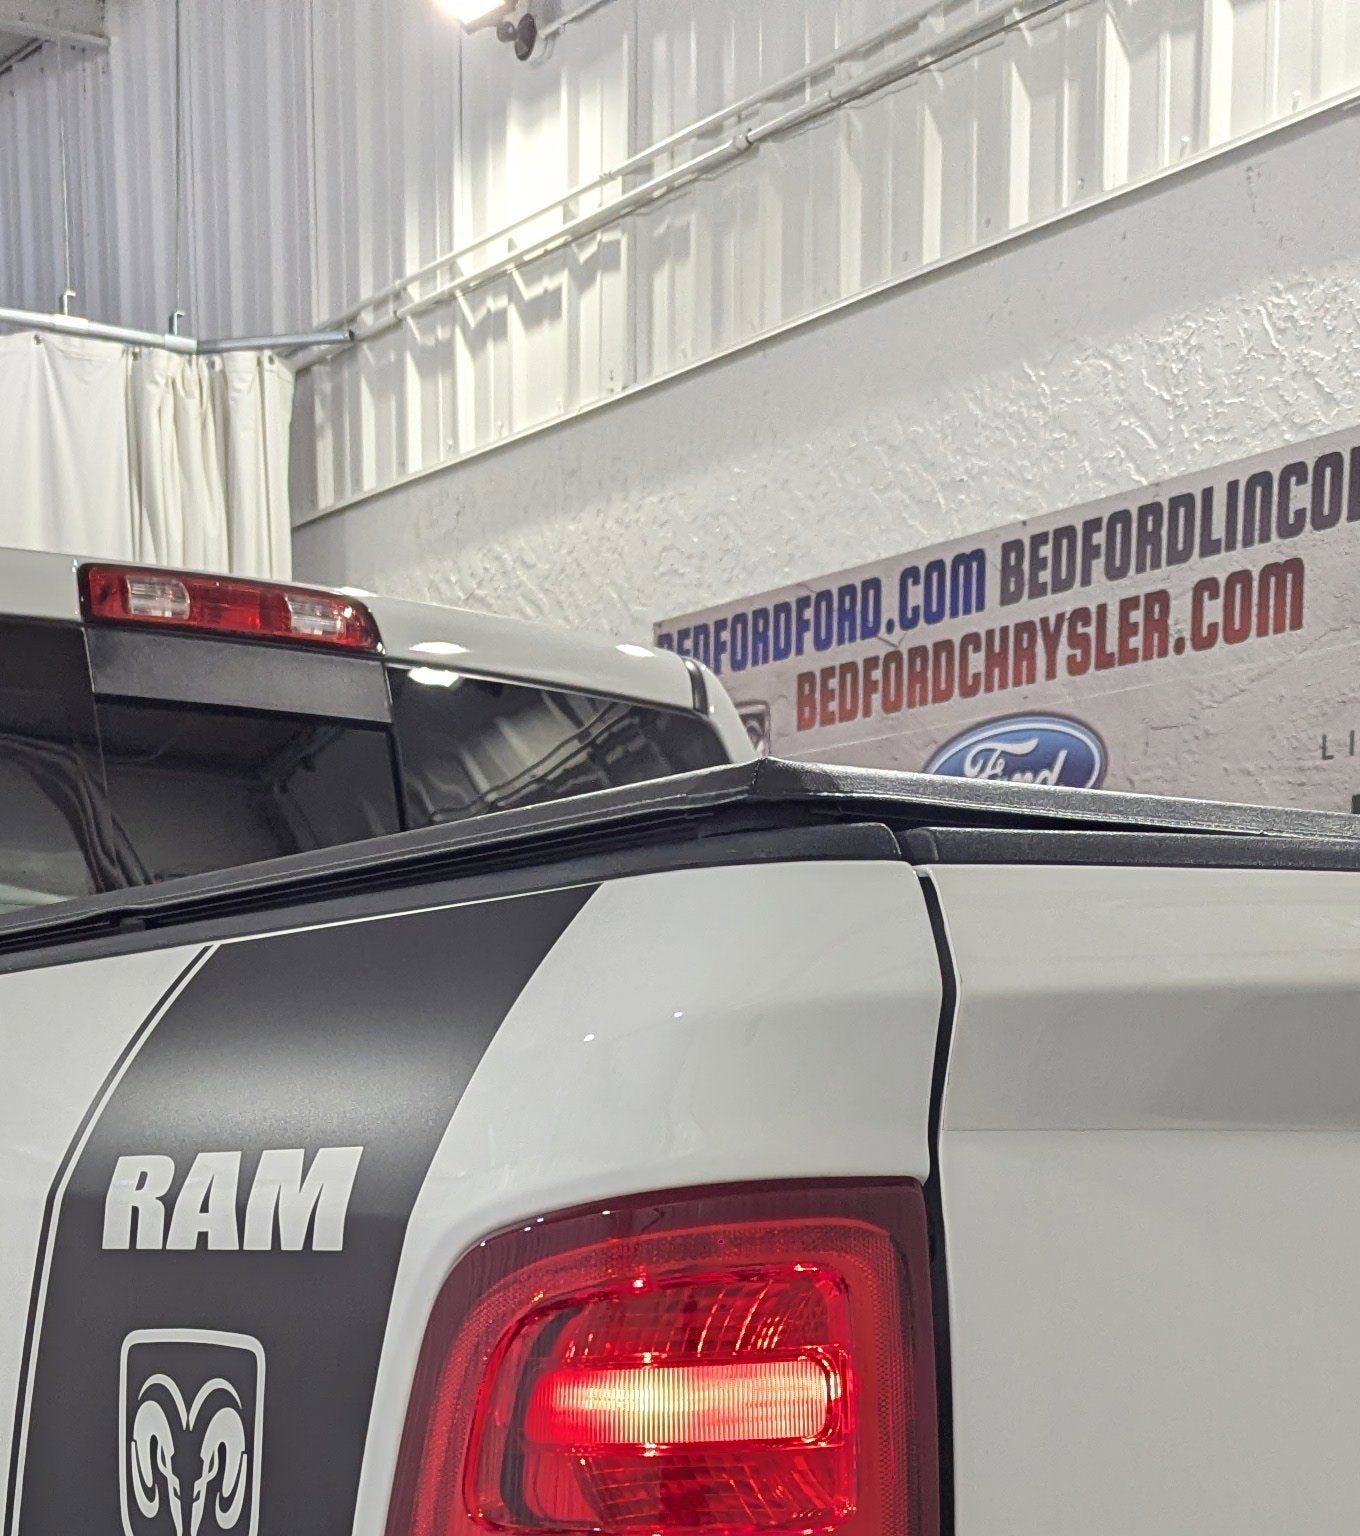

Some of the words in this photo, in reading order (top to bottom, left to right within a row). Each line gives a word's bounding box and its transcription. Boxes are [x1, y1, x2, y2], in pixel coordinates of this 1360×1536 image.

[657, 548, 987, 676] DFORDFORD.COM
[796, 556, 1305, 732] BEDFORDCHRYSLER.COM
[963, 737, 1068, 787] Fd
[101, 1146, 364, 1252] RAM
